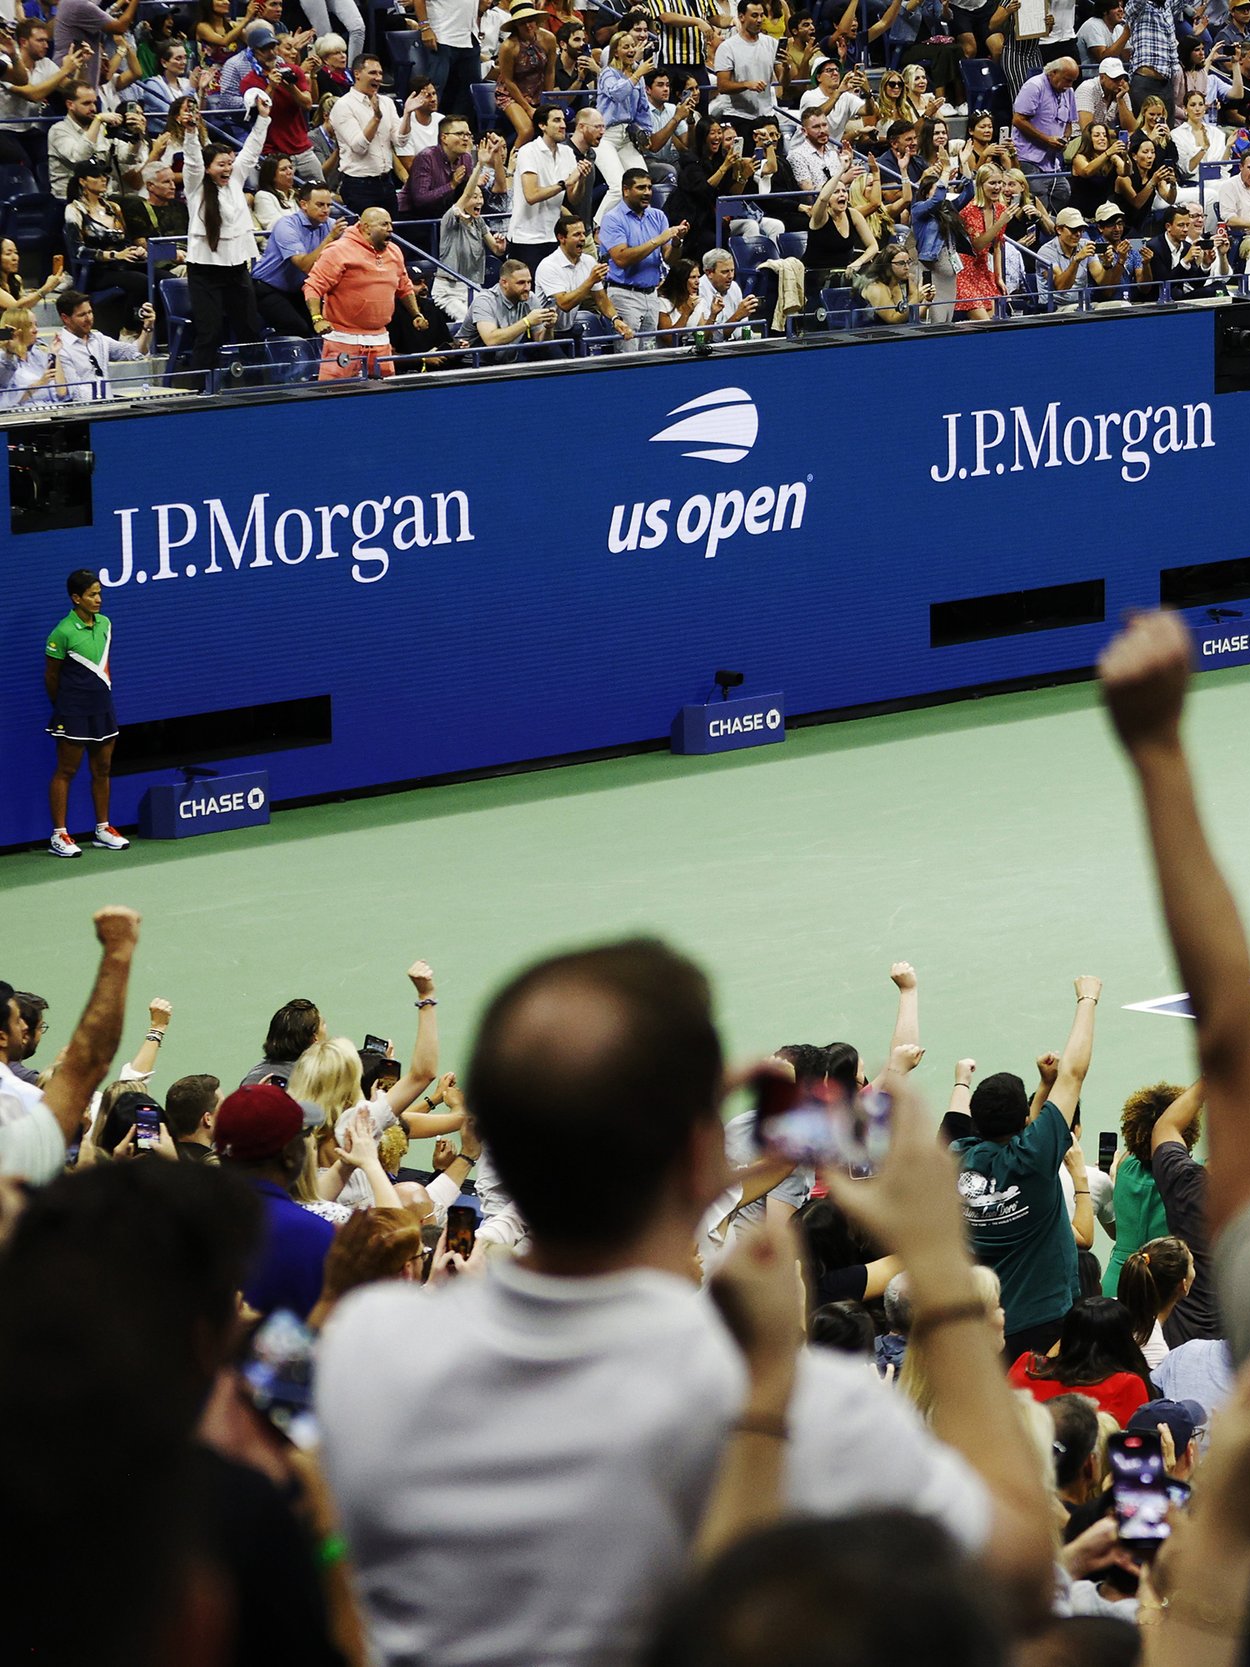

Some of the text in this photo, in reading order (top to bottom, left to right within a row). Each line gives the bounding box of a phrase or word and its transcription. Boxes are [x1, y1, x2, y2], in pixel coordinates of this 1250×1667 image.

[930, 401, 1216, 483] J.P.Morgan
[99, 491, 475, 588] J.P.Morgan
[607, 498, 672, 554] us
[1202, 634, 1249, 656] CHASE
[709, 713, 764, 737] CHASE
[179, 792, 245, 819] CHASE
